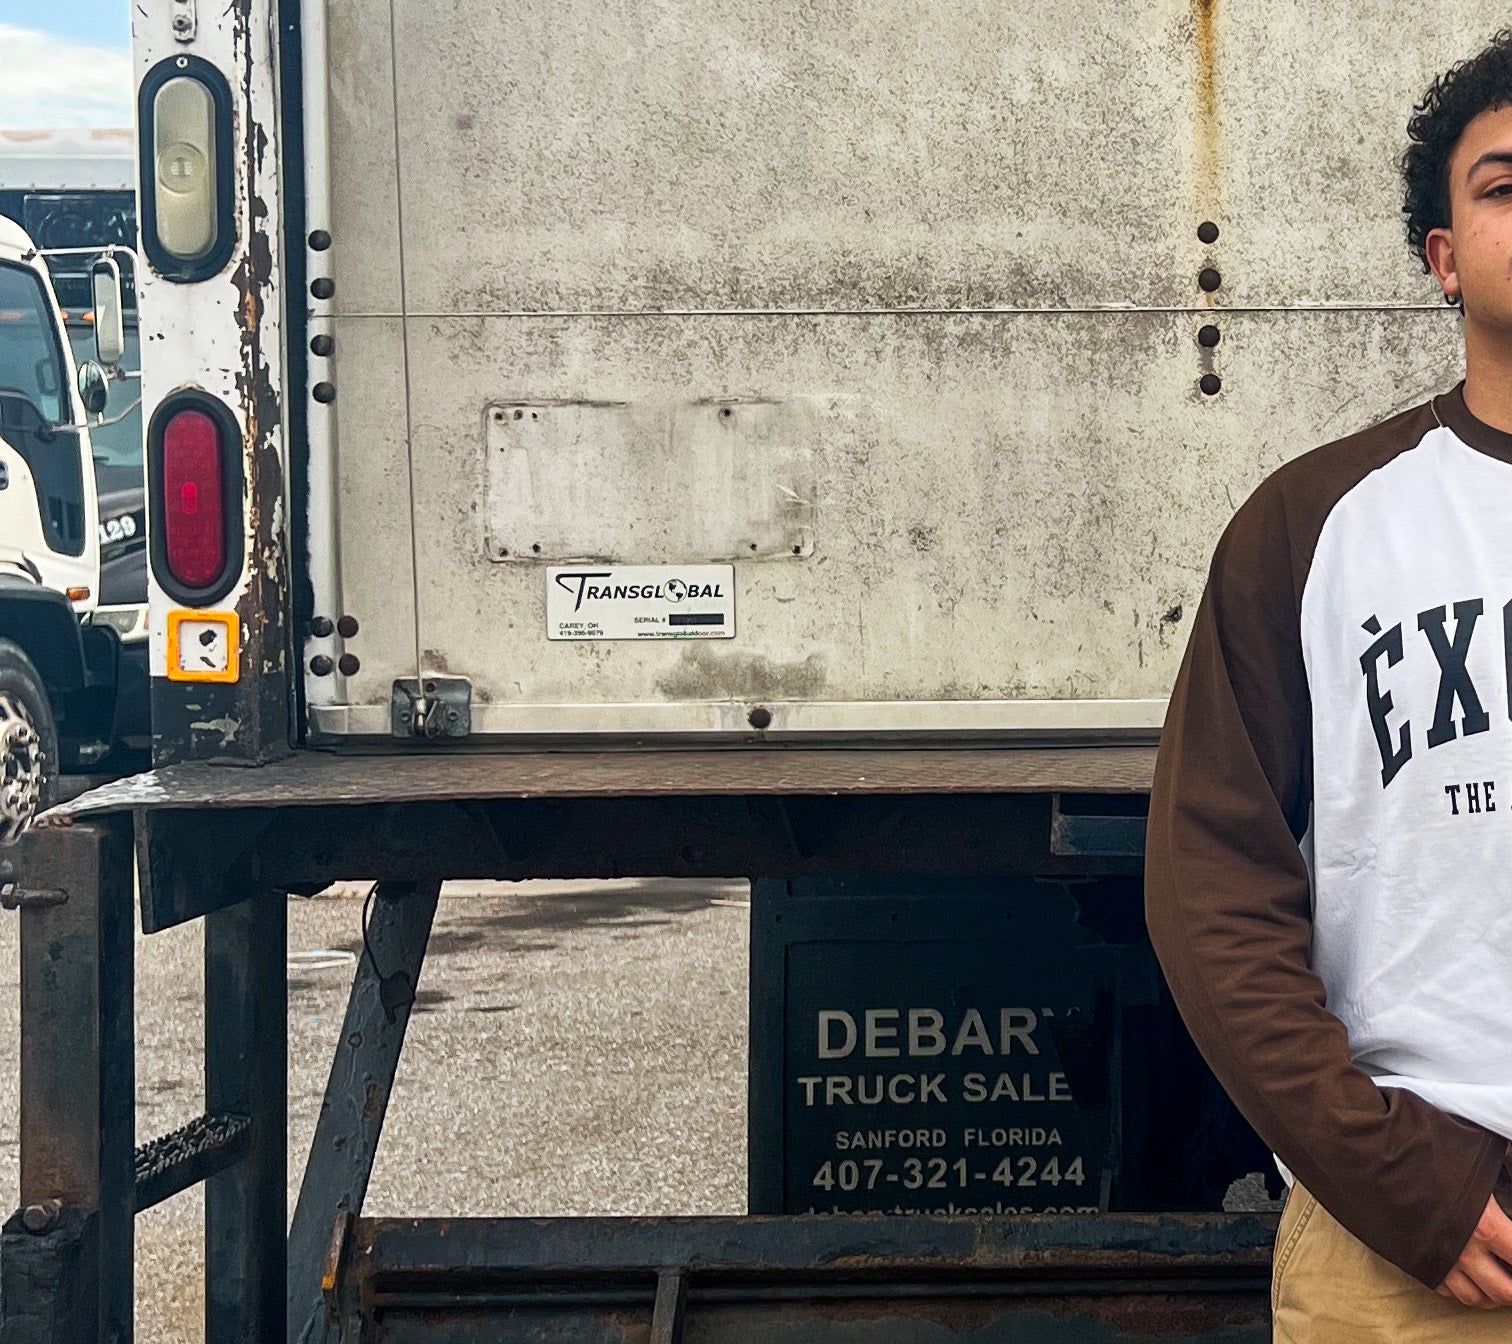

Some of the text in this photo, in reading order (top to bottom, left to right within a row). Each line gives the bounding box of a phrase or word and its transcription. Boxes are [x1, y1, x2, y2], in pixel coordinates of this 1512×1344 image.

[634, 616, 660, 624] SERIAL
[1445, 782, 1496, 815] THE
[818, 1007, 1081, 1060] DEBAR
[797, 1072, 1074, 1106] TRUCK SALE
[835, 1128, 1063, 1150] SANFORD FLORIDA
[812, 1156, 1086, 1192] 407-321-4244
